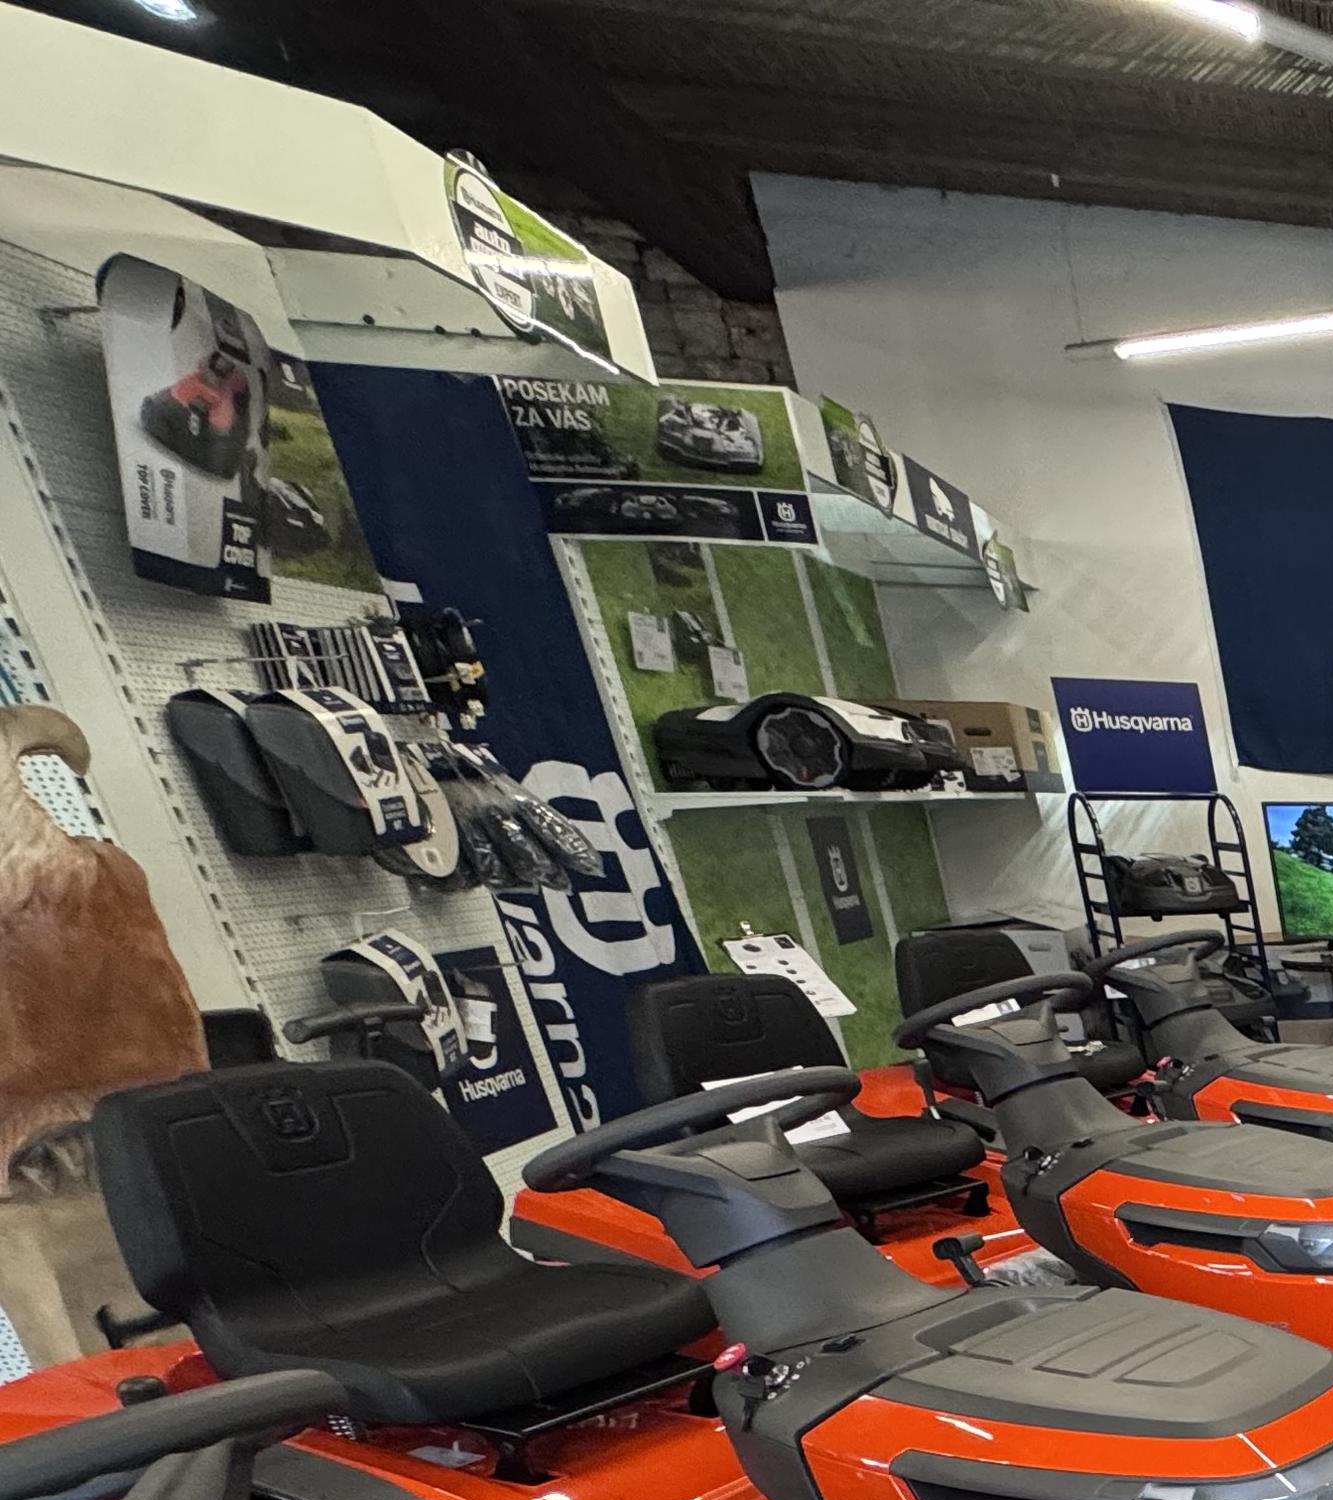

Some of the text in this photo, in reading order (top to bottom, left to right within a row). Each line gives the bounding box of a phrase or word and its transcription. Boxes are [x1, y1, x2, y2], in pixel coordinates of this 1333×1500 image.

[511, 405, 592, 431] ZA VÁS
[1092, 710, 1193, 733] Husqvarna
[458, 1068, 526, 1102] Husqvarna
